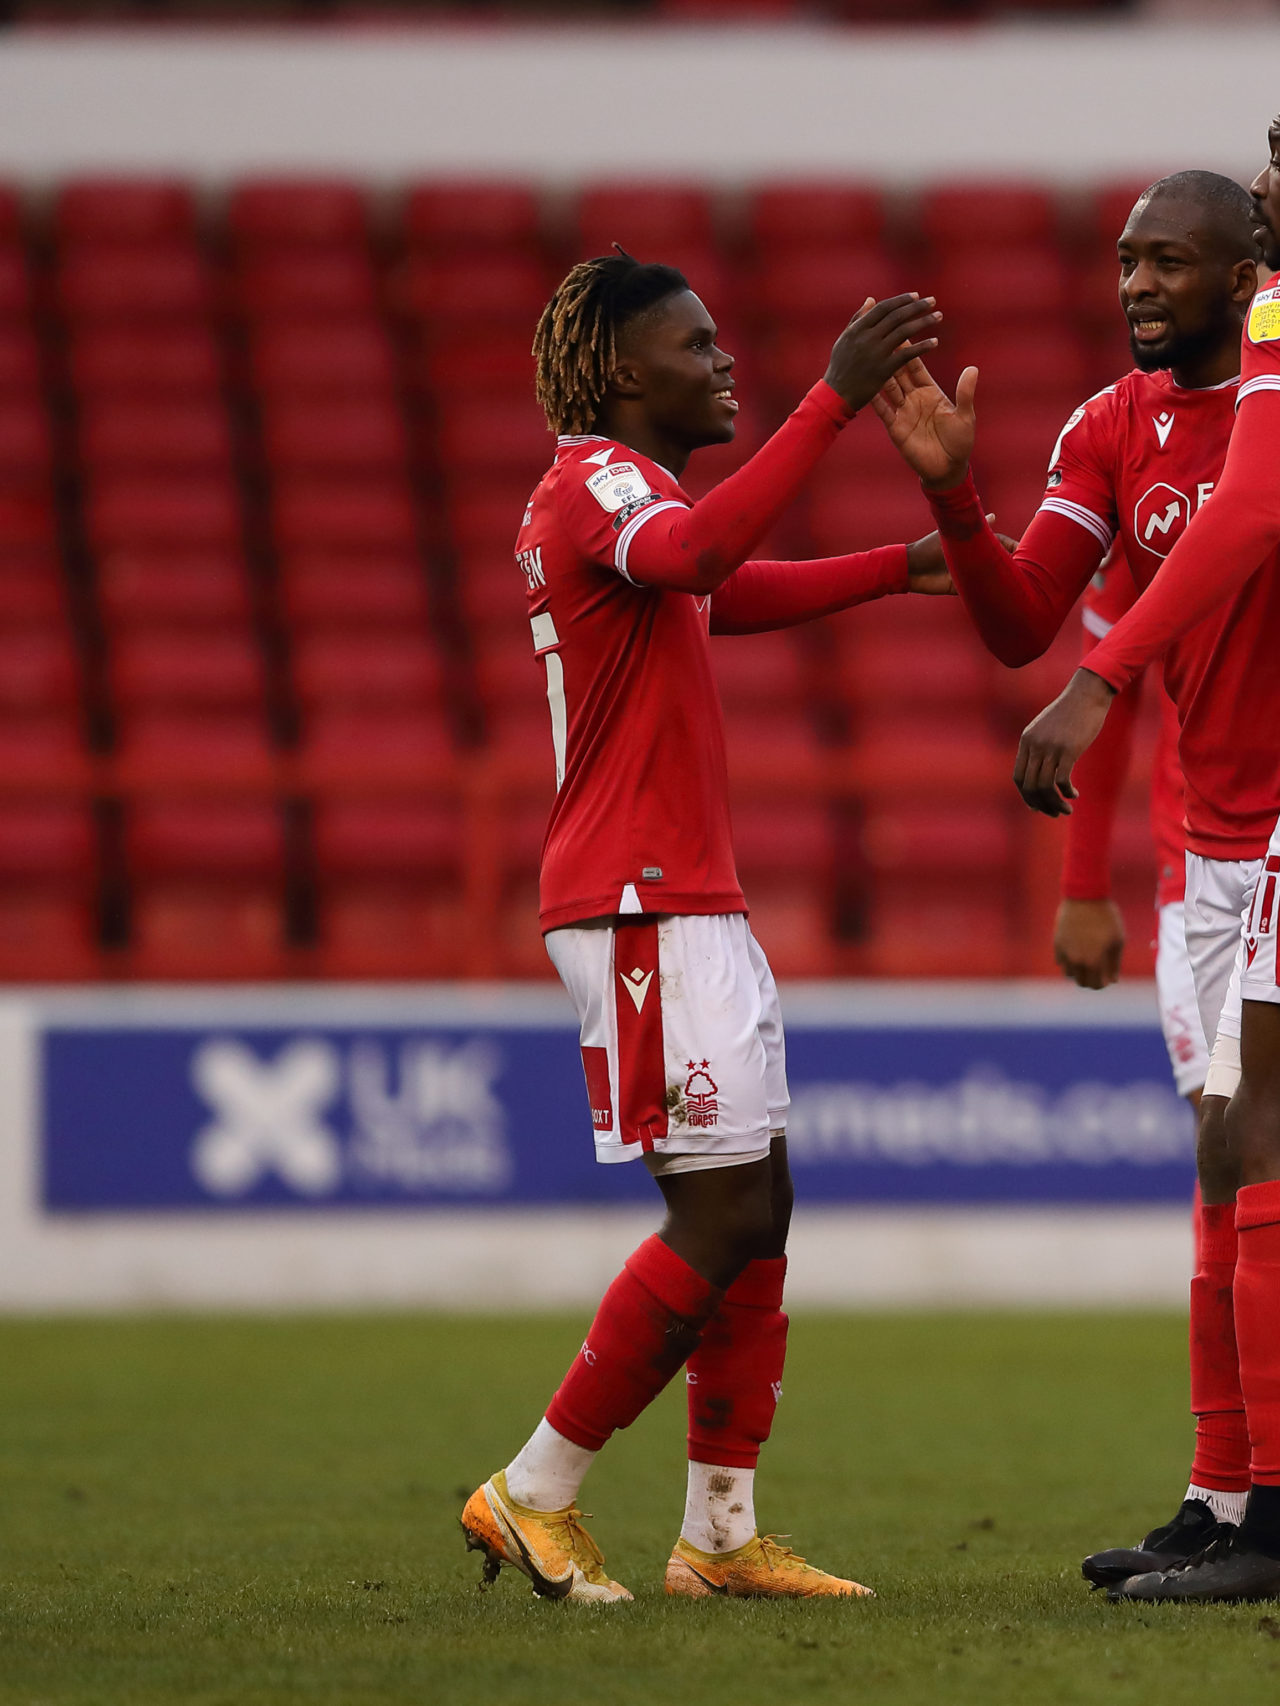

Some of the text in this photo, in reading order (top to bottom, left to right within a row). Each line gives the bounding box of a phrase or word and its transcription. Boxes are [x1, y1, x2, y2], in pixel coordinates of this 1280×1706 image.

[1257, 292, 1271, 302] sky
[593, 473, 608, 487] sky
[612, 466, 633, 474] bet
[621, 494, 638, 504] EFL
[688, 1113, 719, 1129] FOREST
